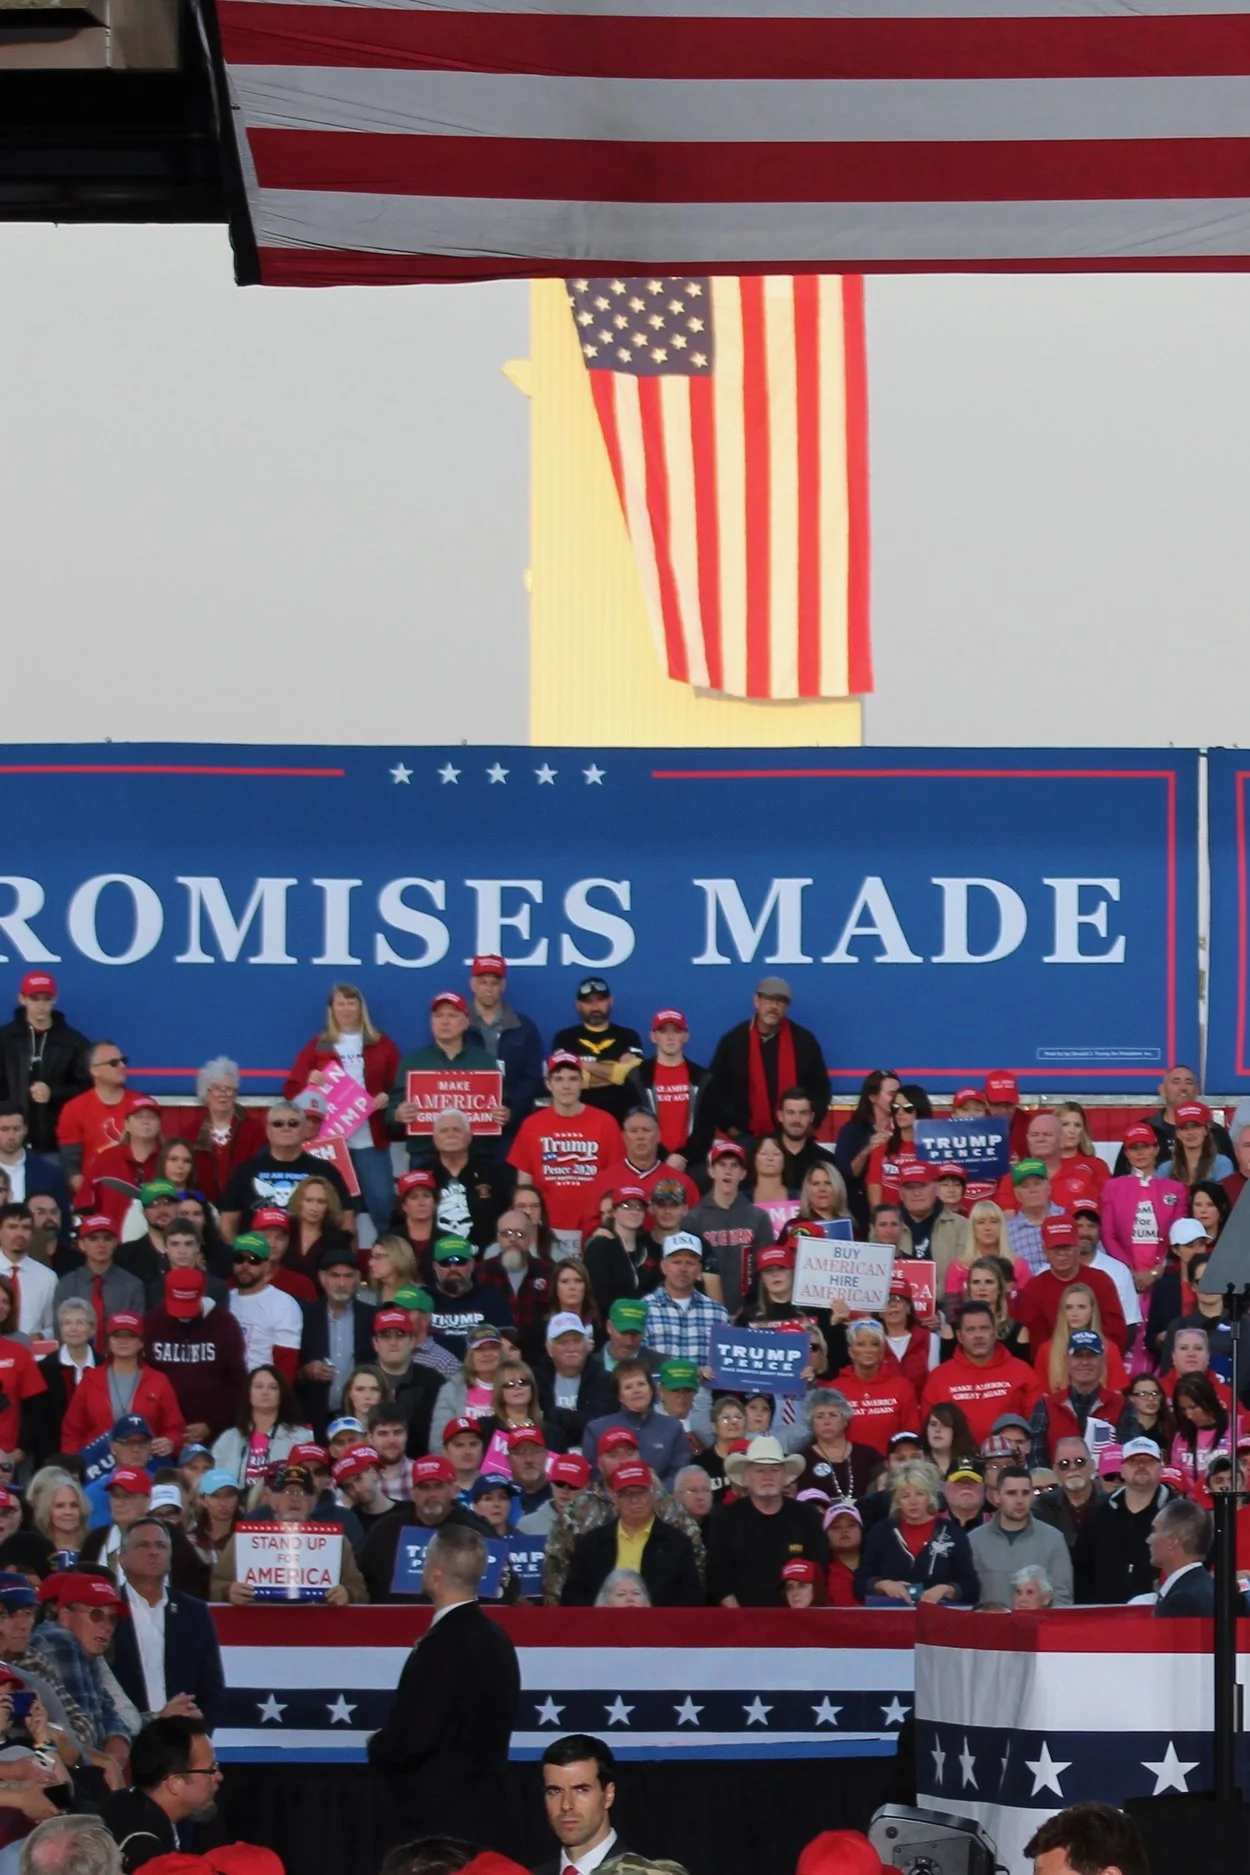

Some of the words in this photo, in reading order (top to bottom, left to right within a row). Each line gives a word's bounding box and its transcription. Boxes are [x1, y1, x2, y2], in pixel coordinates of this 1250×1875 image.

[692, 876, 1126, 964] MADE
[438, 1080, 471, 1091] MAKE
[412, 1094, 498, 1110] AMERICA
[416, 1112, 441, 1123] GRE
[466, 1112, 494, 1122] GAIN
[540, 1136, 598, 1156] Trump
[922, 1135, 1002, 1150] TRUMP
[930, 1148, 996, 1158] PENCE
[574, 1164, 598, 1176] 2020
[1132, 1229, 1156, 1238] RUM
[671, 1236, 694, 1246] USA
[834, 1247, 860, 1260] BUY
[802, 1256, 887, 1276] AMERICAN
[830, 1275, 860, 1288] HIRE
[801, 1284, 884, 1304] AMERICAN
[432, 1312, 484, 1326] TRUMP
[717, 1344, 802, 1361] TRUMP
[723, 1358, 792, 1370] PENCE
[950, 1384, 973, 1392] MAKE
[975, 1382, 1012, 1391] AMERICA
[953, 1392, 979, 1400] GREAT
[982, 1388, 1008, 1399] AGAIN
[862, 1398, 898, 1407] AMERICA
[868, 1406, 895, 1415] AGAIN
[252, 1536, 302, 1550] STAND
[308, 1538, 327, 1550] UP
[278, 1554, 300, 1563] FOR
[245, 1567, 332, 1586] AMERICA
